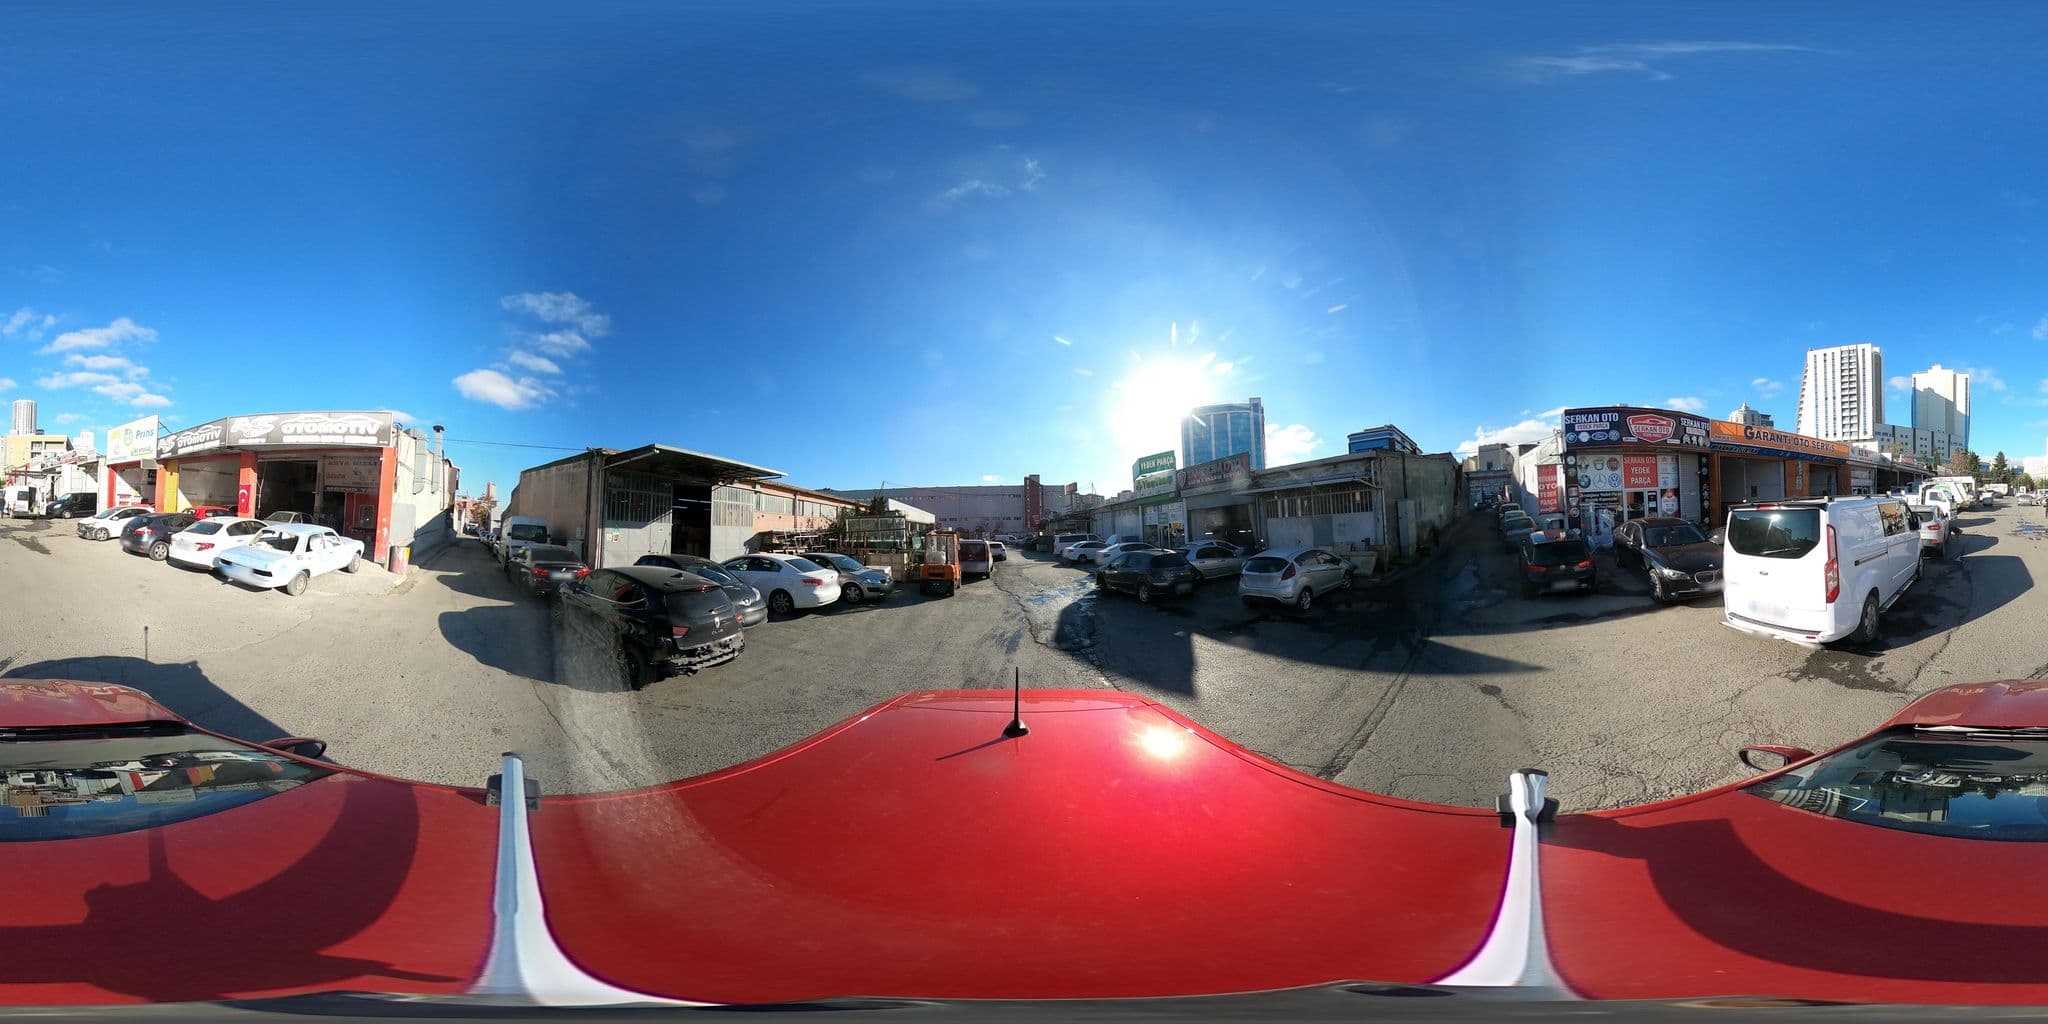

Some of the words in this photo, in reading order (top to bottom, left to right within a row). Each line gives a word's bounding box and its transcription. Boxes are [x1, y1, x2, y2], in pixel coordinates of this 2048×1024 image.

[1565, 413, 1599, 424] SERKAN
[1601, 412, 1619, 423] OTO
[1680, 417, 1700, 428] SERKAN
[135, 429, 154, 440] Prins
[1793, 437, 1810, 448] OTO
[1624, 456, 1645, 464] SERKAN
[1631, 466, 1650, 474] YEDEK
[1539, 482, 1557, 490] OTO
[1631, 477, 1651, 486] PARÇA
